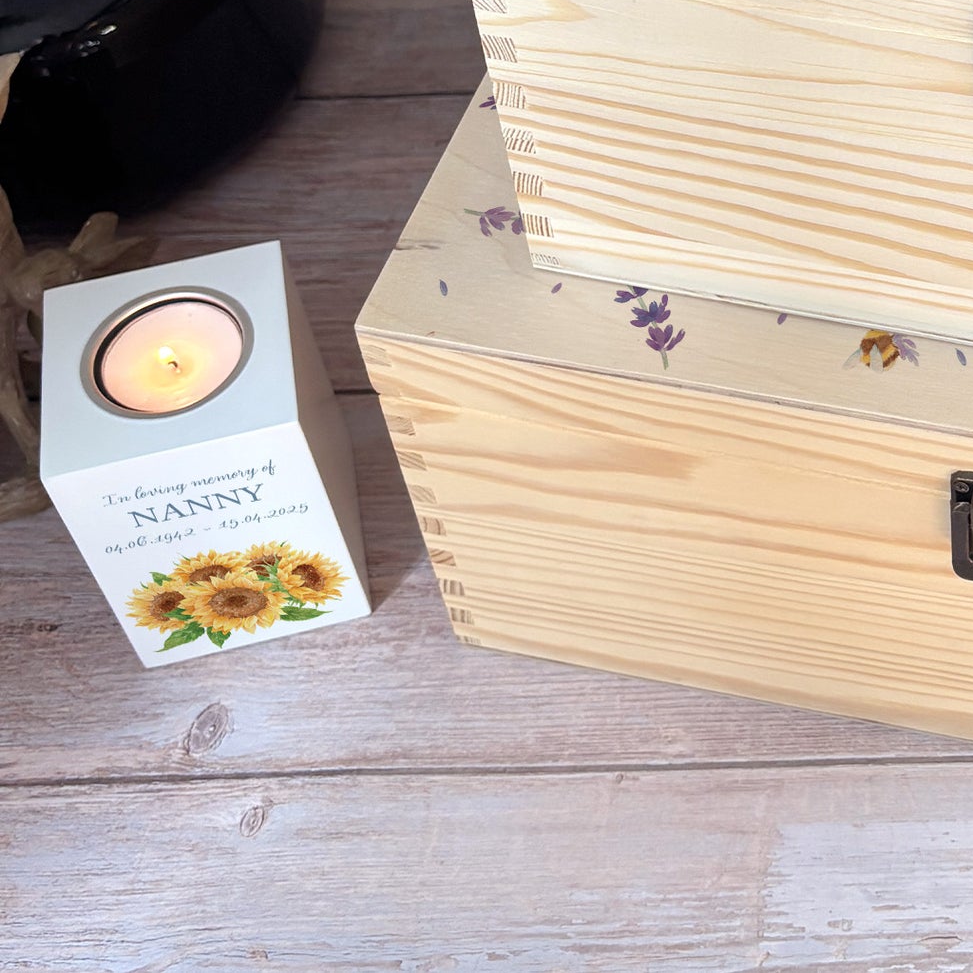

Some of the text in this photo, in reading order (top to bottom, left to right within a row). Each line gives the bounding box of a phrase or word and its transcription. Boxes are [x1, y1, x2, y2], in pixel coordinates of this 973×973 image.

[102, 459, 276, 507] In loving memory of
[127, 483, 265, 528] NANNY
[105, 527, 197, 554] 04.06.1942
